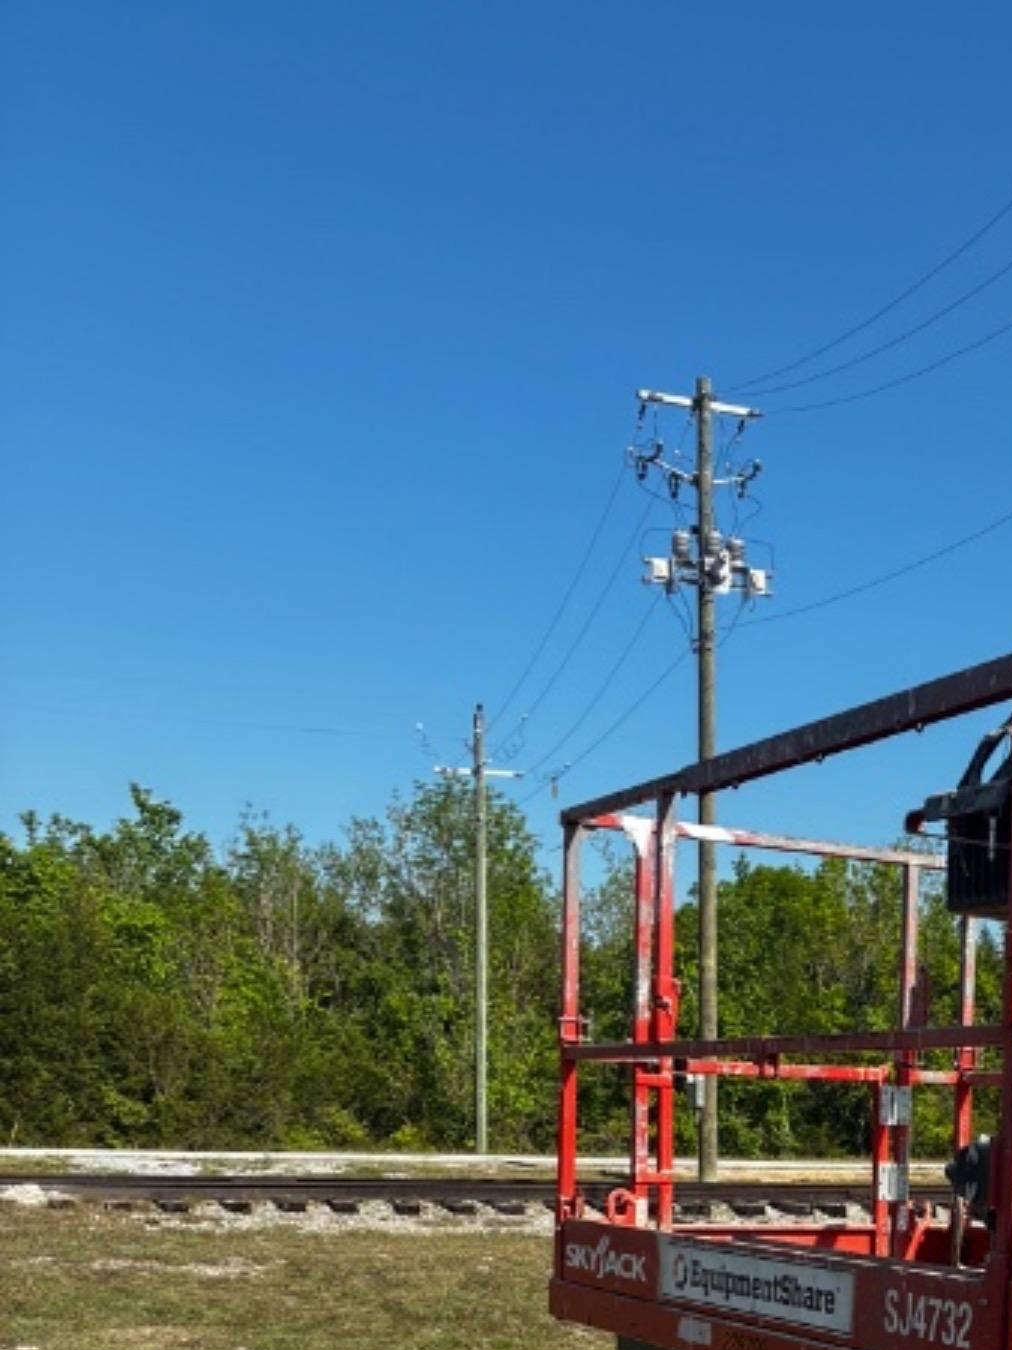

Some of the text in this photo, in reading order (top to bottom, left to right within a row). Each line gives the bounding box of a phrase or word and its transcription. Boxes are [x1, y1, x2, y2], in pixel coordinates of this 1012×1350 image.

[564, 1234, 648, 1282] SKYJACK
[690, 1259, 835, 1315] EquipmentShare
[884, 1289, 973, 1350] SJ4732
